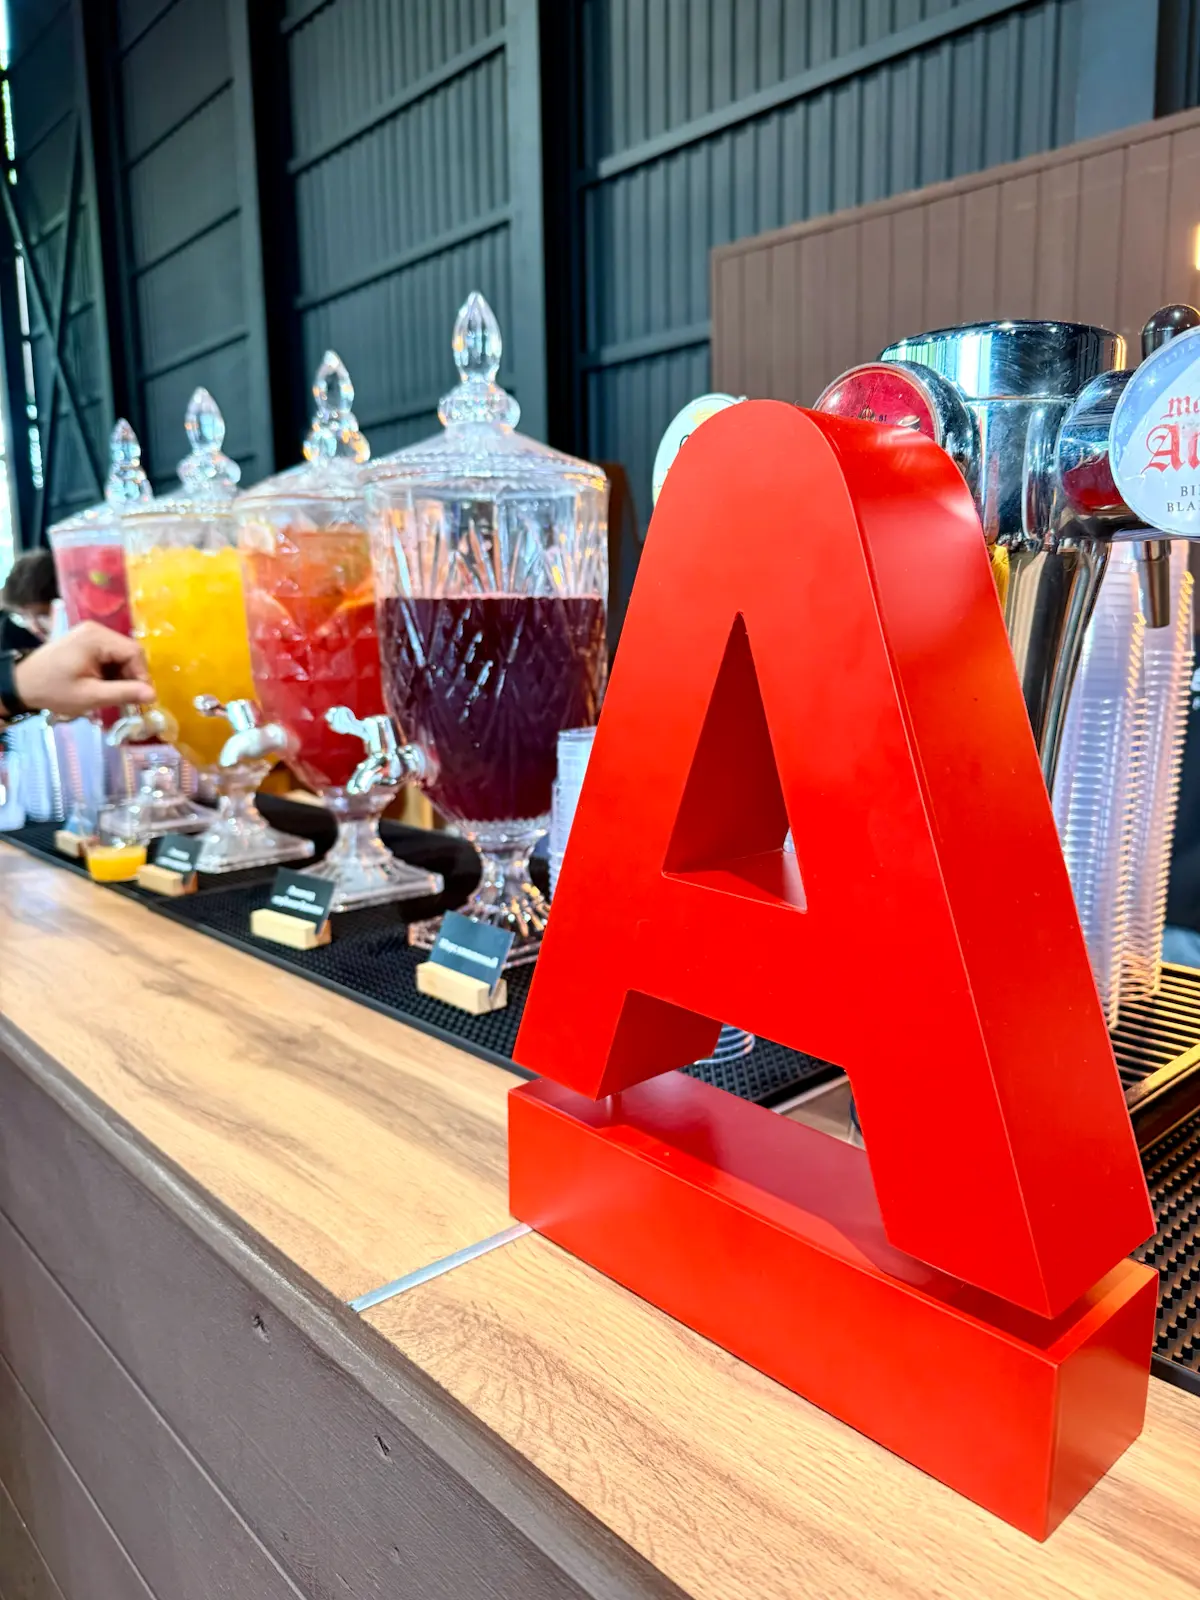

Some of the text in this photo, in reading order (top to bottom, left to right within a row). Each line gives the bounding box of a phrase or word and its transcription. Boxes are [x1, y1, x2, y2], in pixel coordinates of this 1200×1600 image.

[1180, 484, 1200, 497] BI
[1166, 500, 1200, 513] BLA
[514, 399, 1156, 1318] A
